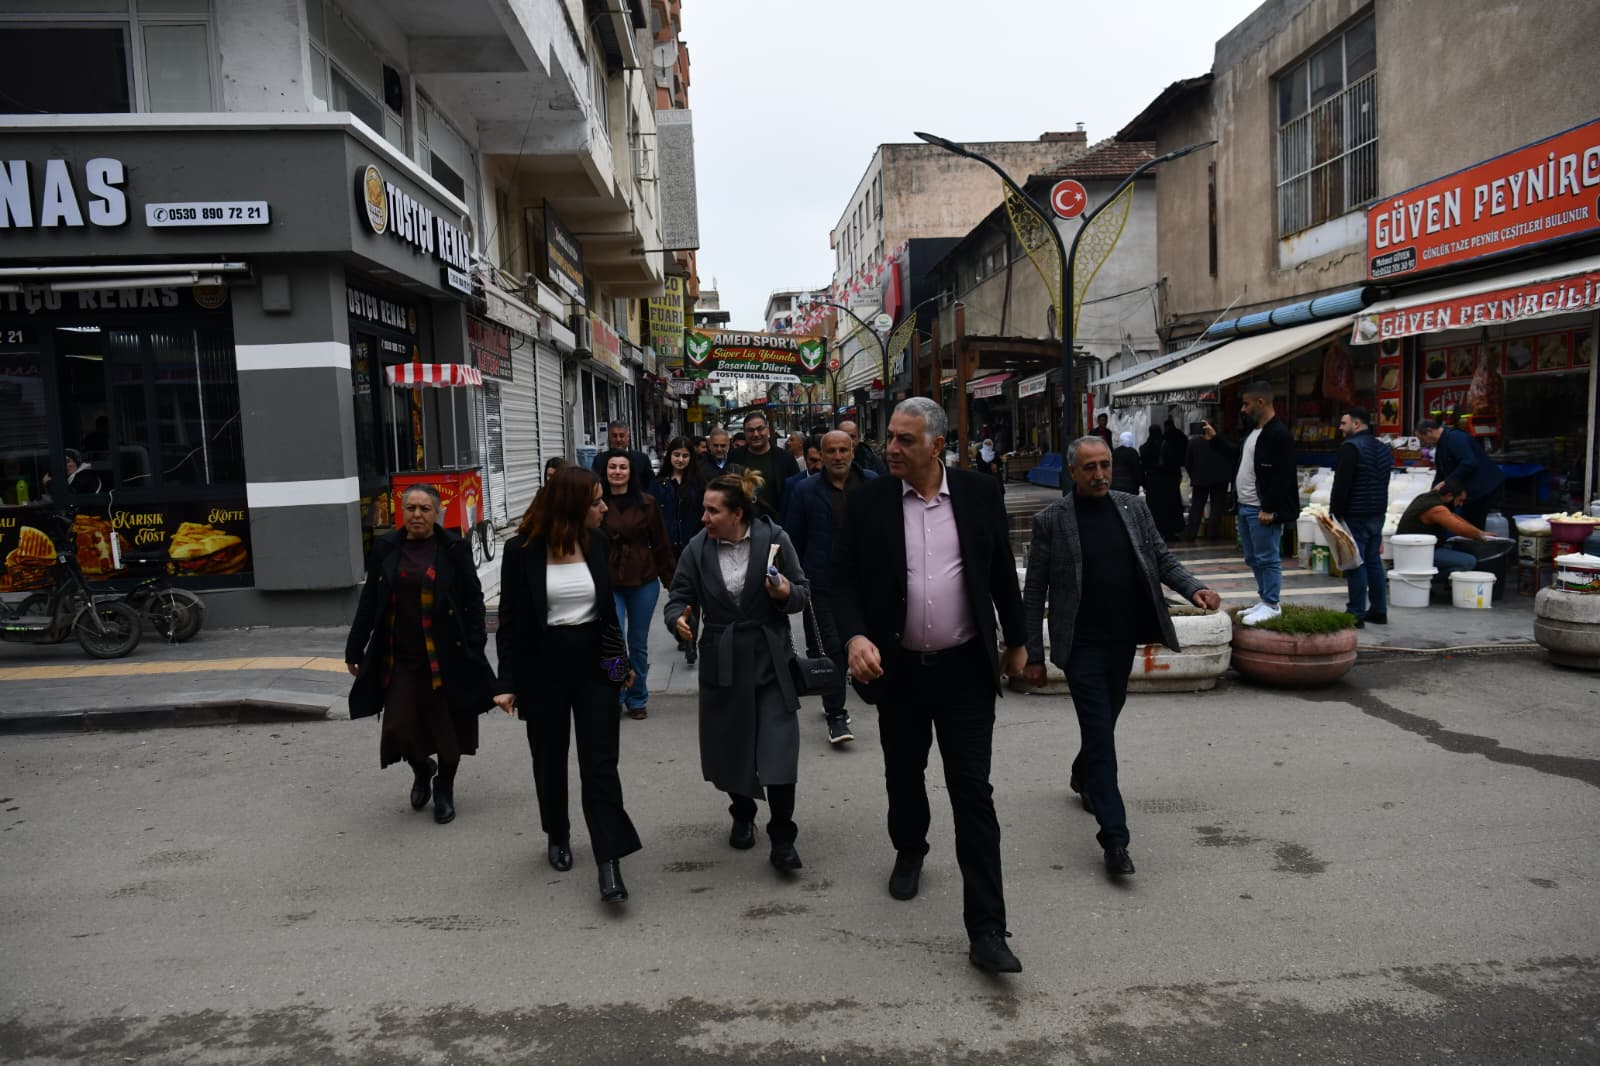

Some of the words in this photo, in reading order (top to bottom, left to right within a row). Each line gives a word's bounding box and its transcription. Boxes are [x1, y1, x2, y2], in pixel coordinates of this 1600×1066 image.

[169, 208, 197, 220] 0530
[202, 208, 224, 220] 890
[228, 207, 243, 219] 72
[247, 207, 261, 219] 21
[1375, 187, 1461, 249] GÜVEN
[386, 182, 434, 254] TOSTÇU
[436, 216, 470, 273] RENAS
[1422, 243, 1450, 260] GÜNLÜK
[1450, 238, 1470, 252] TAZE
[1501, 216, 1543, 243] ÇEŞİTLERİ
[1545, 206, 1589, 228] BULUNUR
[650, 306, 683, 323] FUARI
[1381, 307, 1451, 337] GÜVEN
[1460, 277, 1600, 324] PEYNİRCİLİ
[8, 330, 23, 343] 21
[713, 334, 751, 346] AMED
[753, 336, 798, 349] SPOR'A
[713, 348, 739, 360] Süper
[742, 348, 756, 361] Lig
[759, 350, 796, 362] Yolunda
[717, 360, 760, 371] Başarılar
[762, 362, 791, 373] Dileriz
